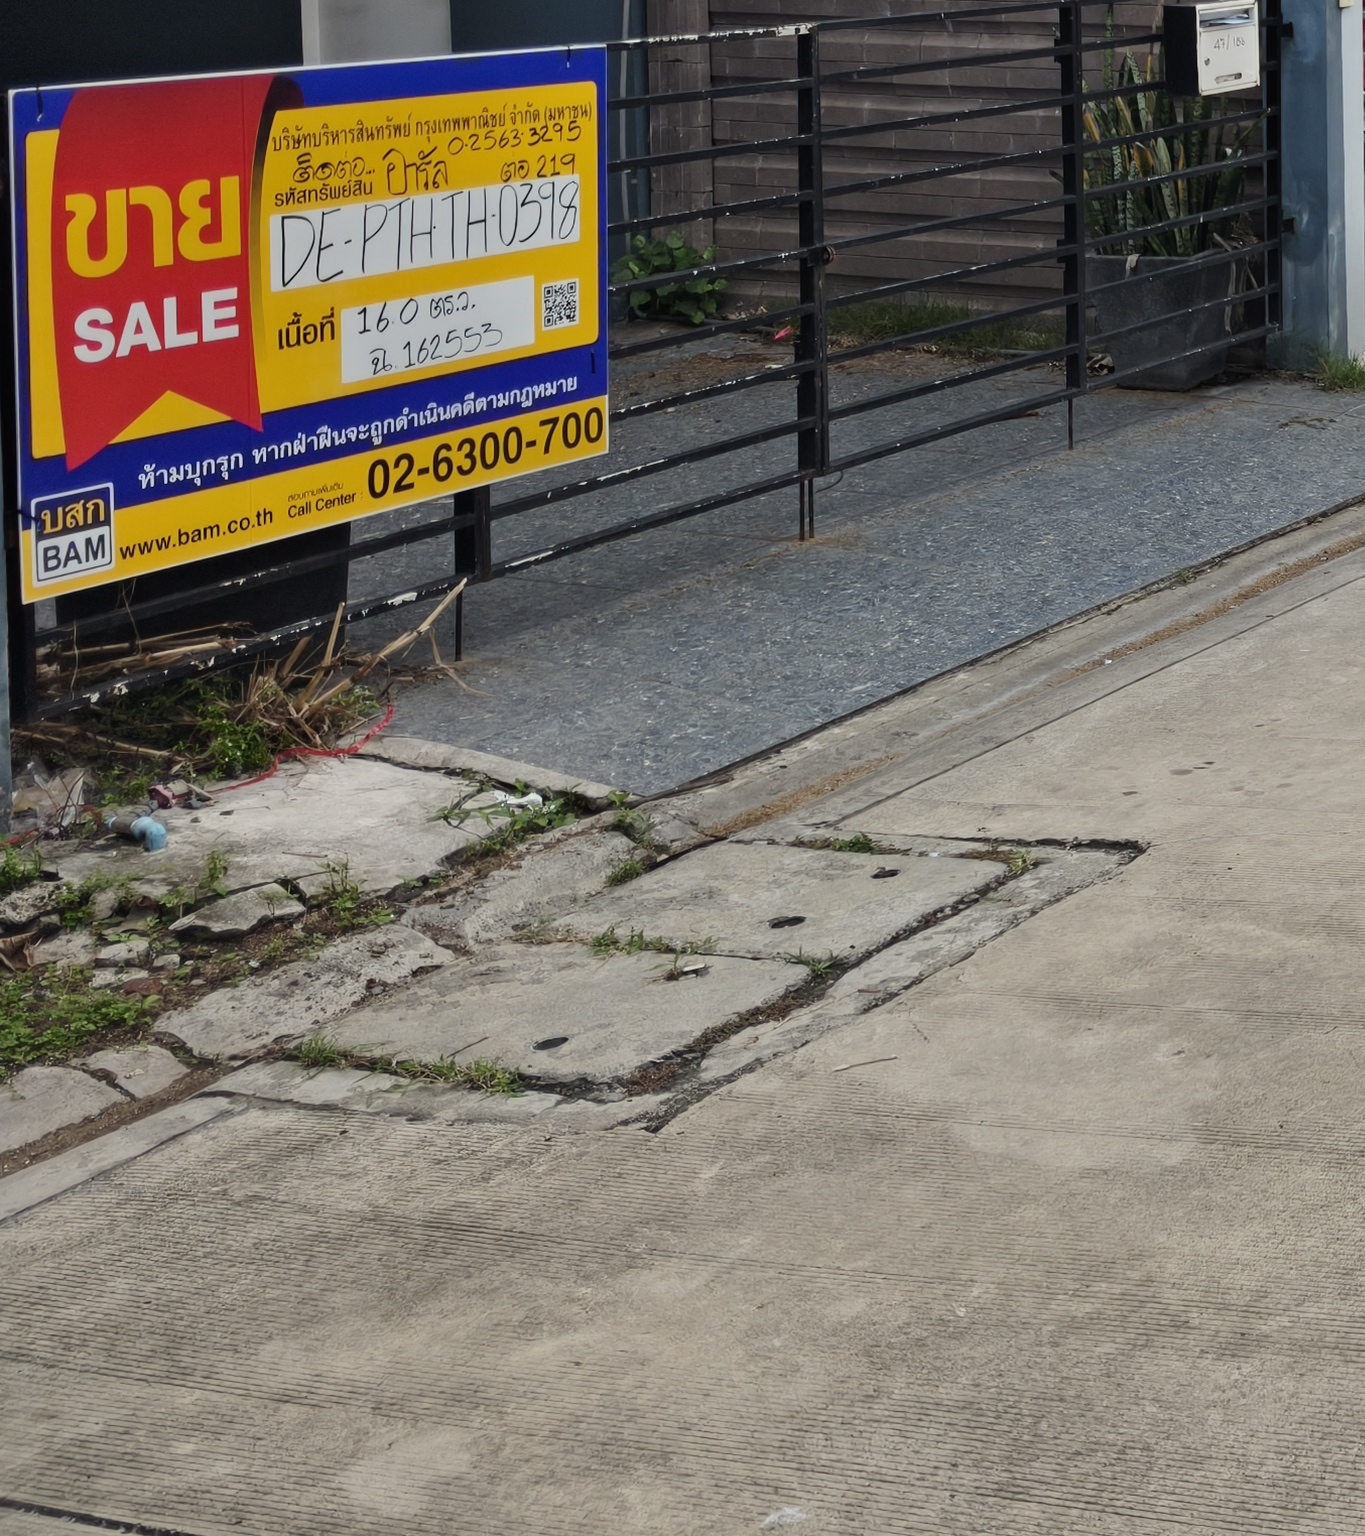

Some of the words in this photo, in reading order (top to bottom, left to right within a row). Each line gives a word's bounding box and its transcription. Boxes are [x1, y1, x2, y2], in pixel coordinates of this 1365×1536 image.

[272, 112, 412, 152] บริษัทบริหารสินทรัพย์
[416, 103, 507, 143] กรุงเทพพาณิชย์
[510, 101, 540, 125] จำกัด
[544, 102, 592, 126] (มหาชน)
[537, 153, 576, 178] 219
[274, 179, 373, 207] รหัสทรัพย์สิน
[65, 175, 241, 278] ขาย
[73, 287, 240, 363] SALE
[278, 307, 336, 350] เนื้อที่
[138, 452, 244, 490] ห้ามบุกรุก
[252, 375, 578, 464] หากฝ่าฝืนจะถูกดำเนินคดีตามกฎหมาย
[368, 407, 604, 500] 02-6300-700
[41, 497, 106, 535] บสก
[287, 501, 312, 519] Call
[315, 492, 357, 512] Center
[42, 533, 106, 573] BAM
[119, 508, 274, 560] www.bam.co.th
